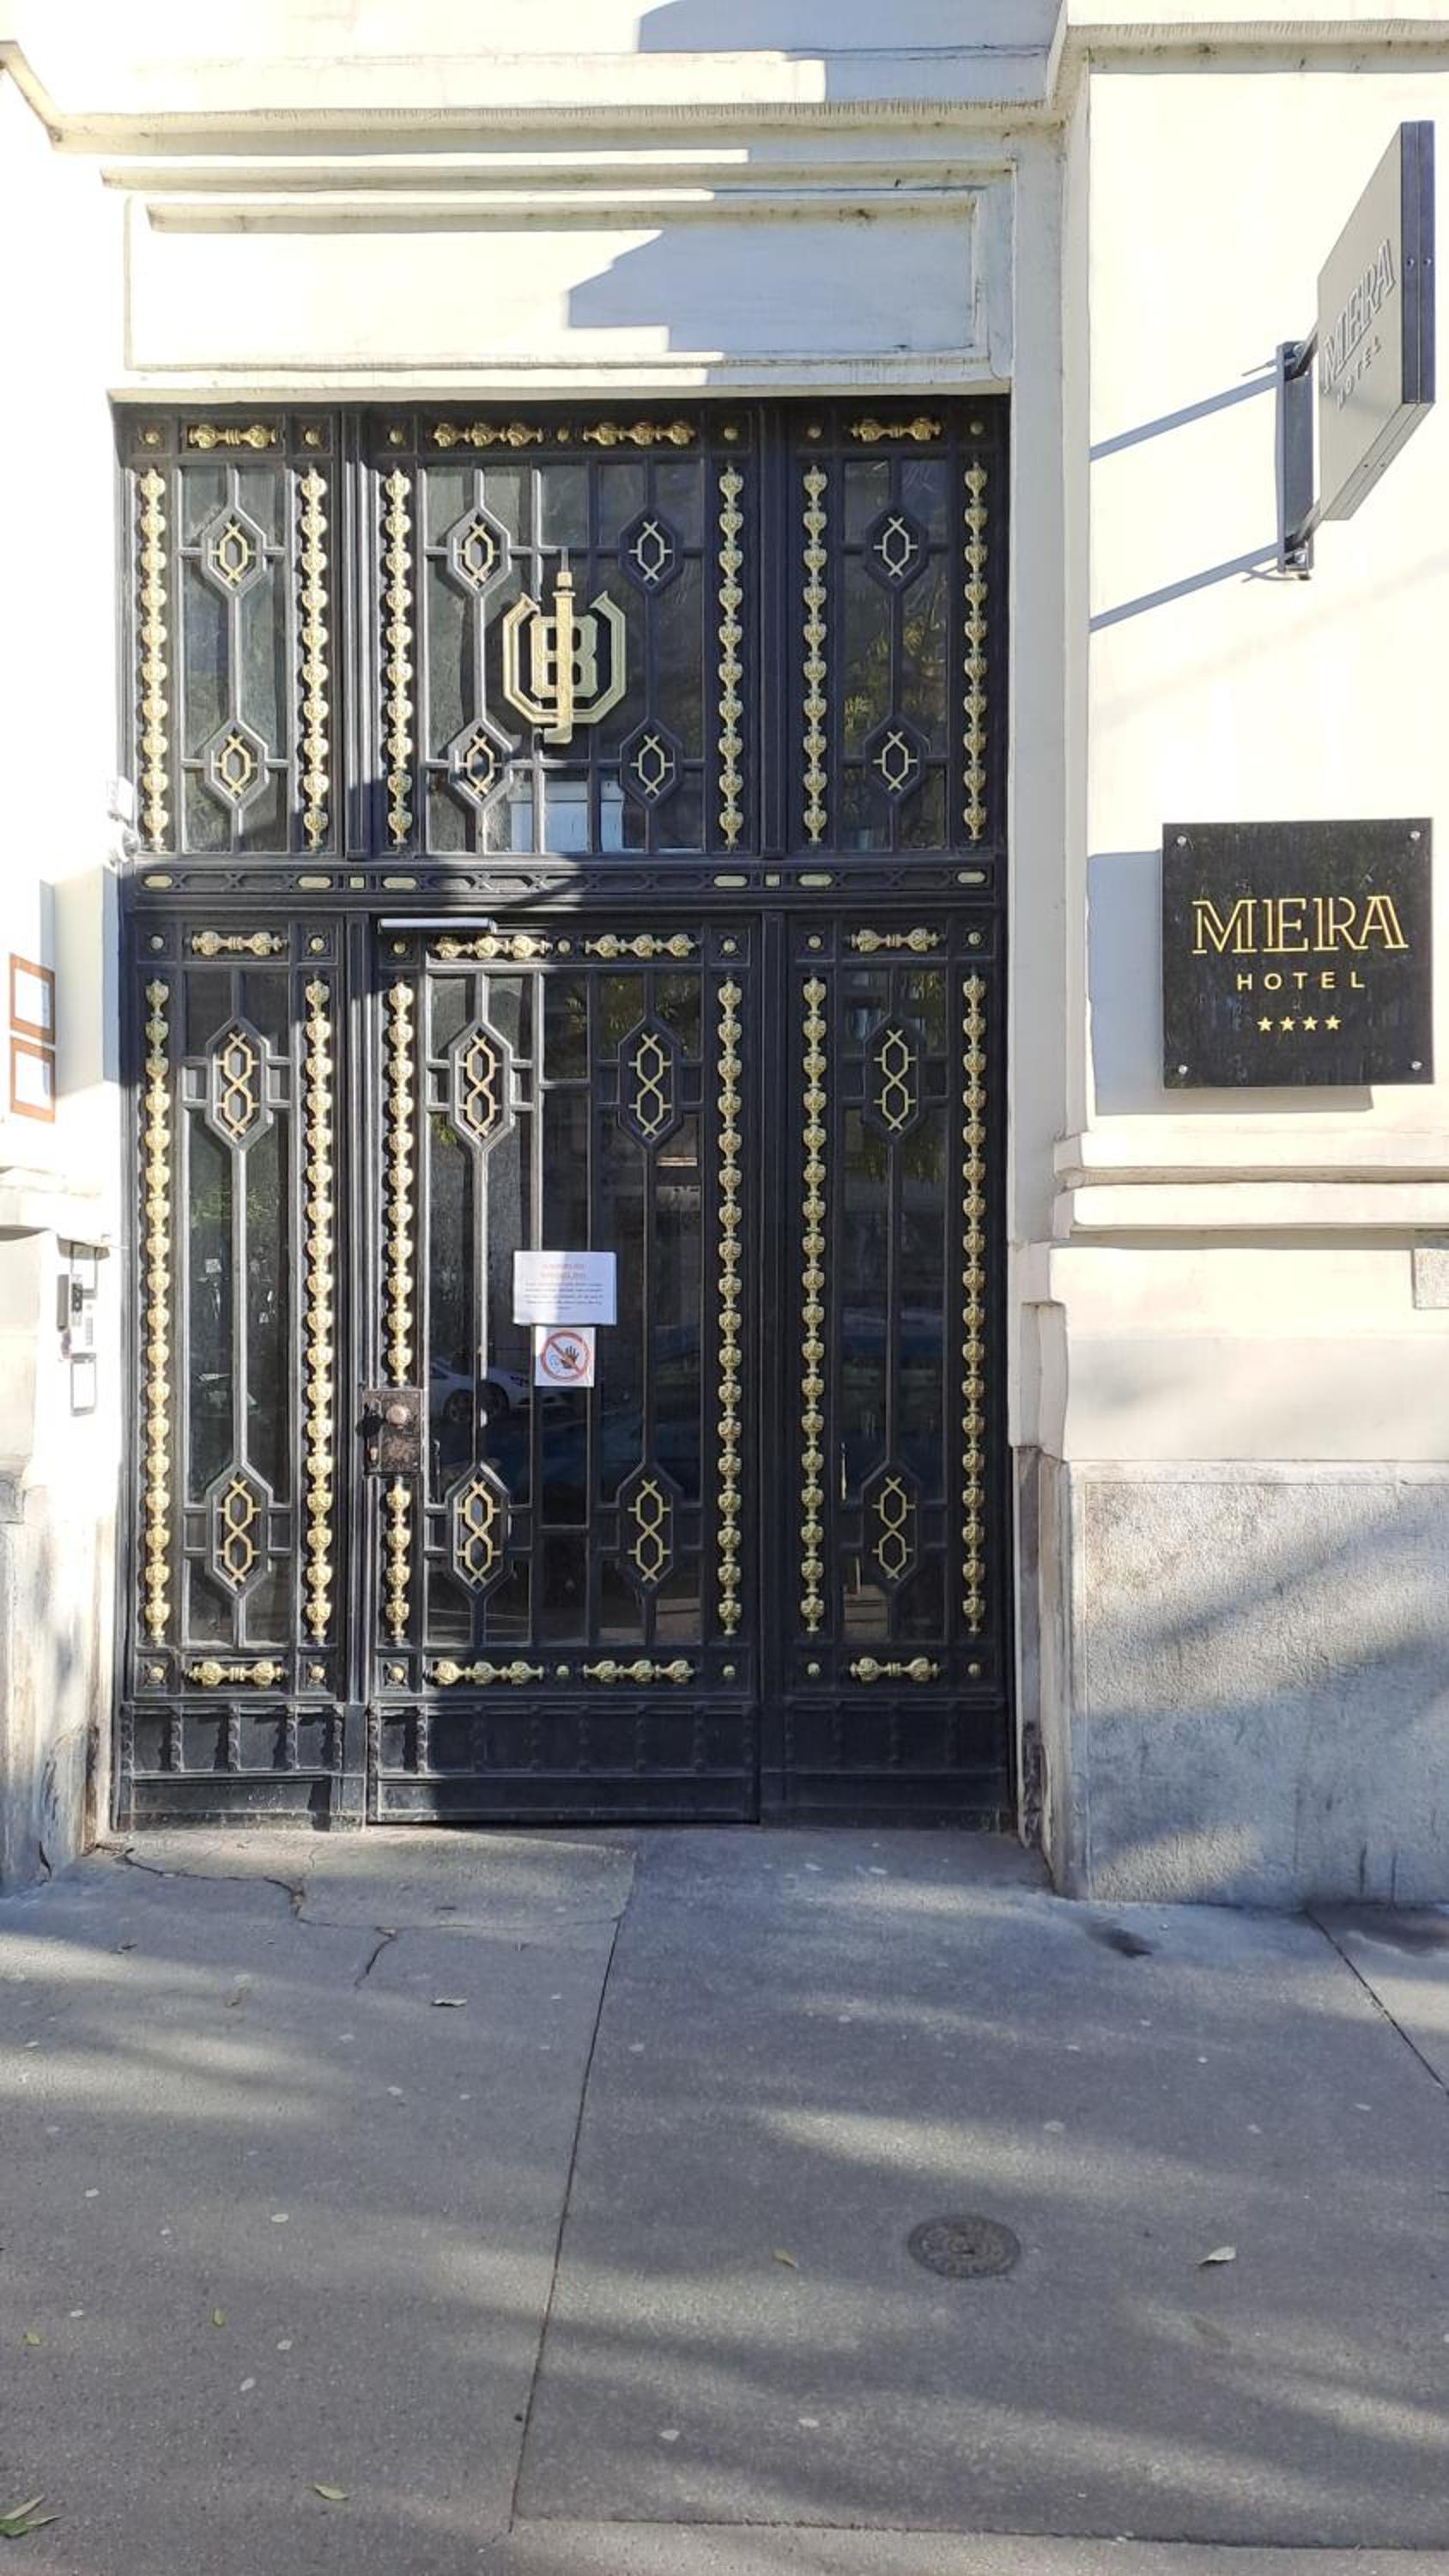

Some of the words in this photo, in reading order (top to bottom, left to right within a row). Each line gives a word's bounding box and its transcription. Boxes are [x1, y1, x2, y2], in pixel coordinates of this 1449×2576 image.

[1323, 238, 1396, 397] MERA
[1337, 336, 1382, 411] HOTEL
[1191, 896, 1410, 954] MERA
[1236, 971, 1365, 990] HOTEL
